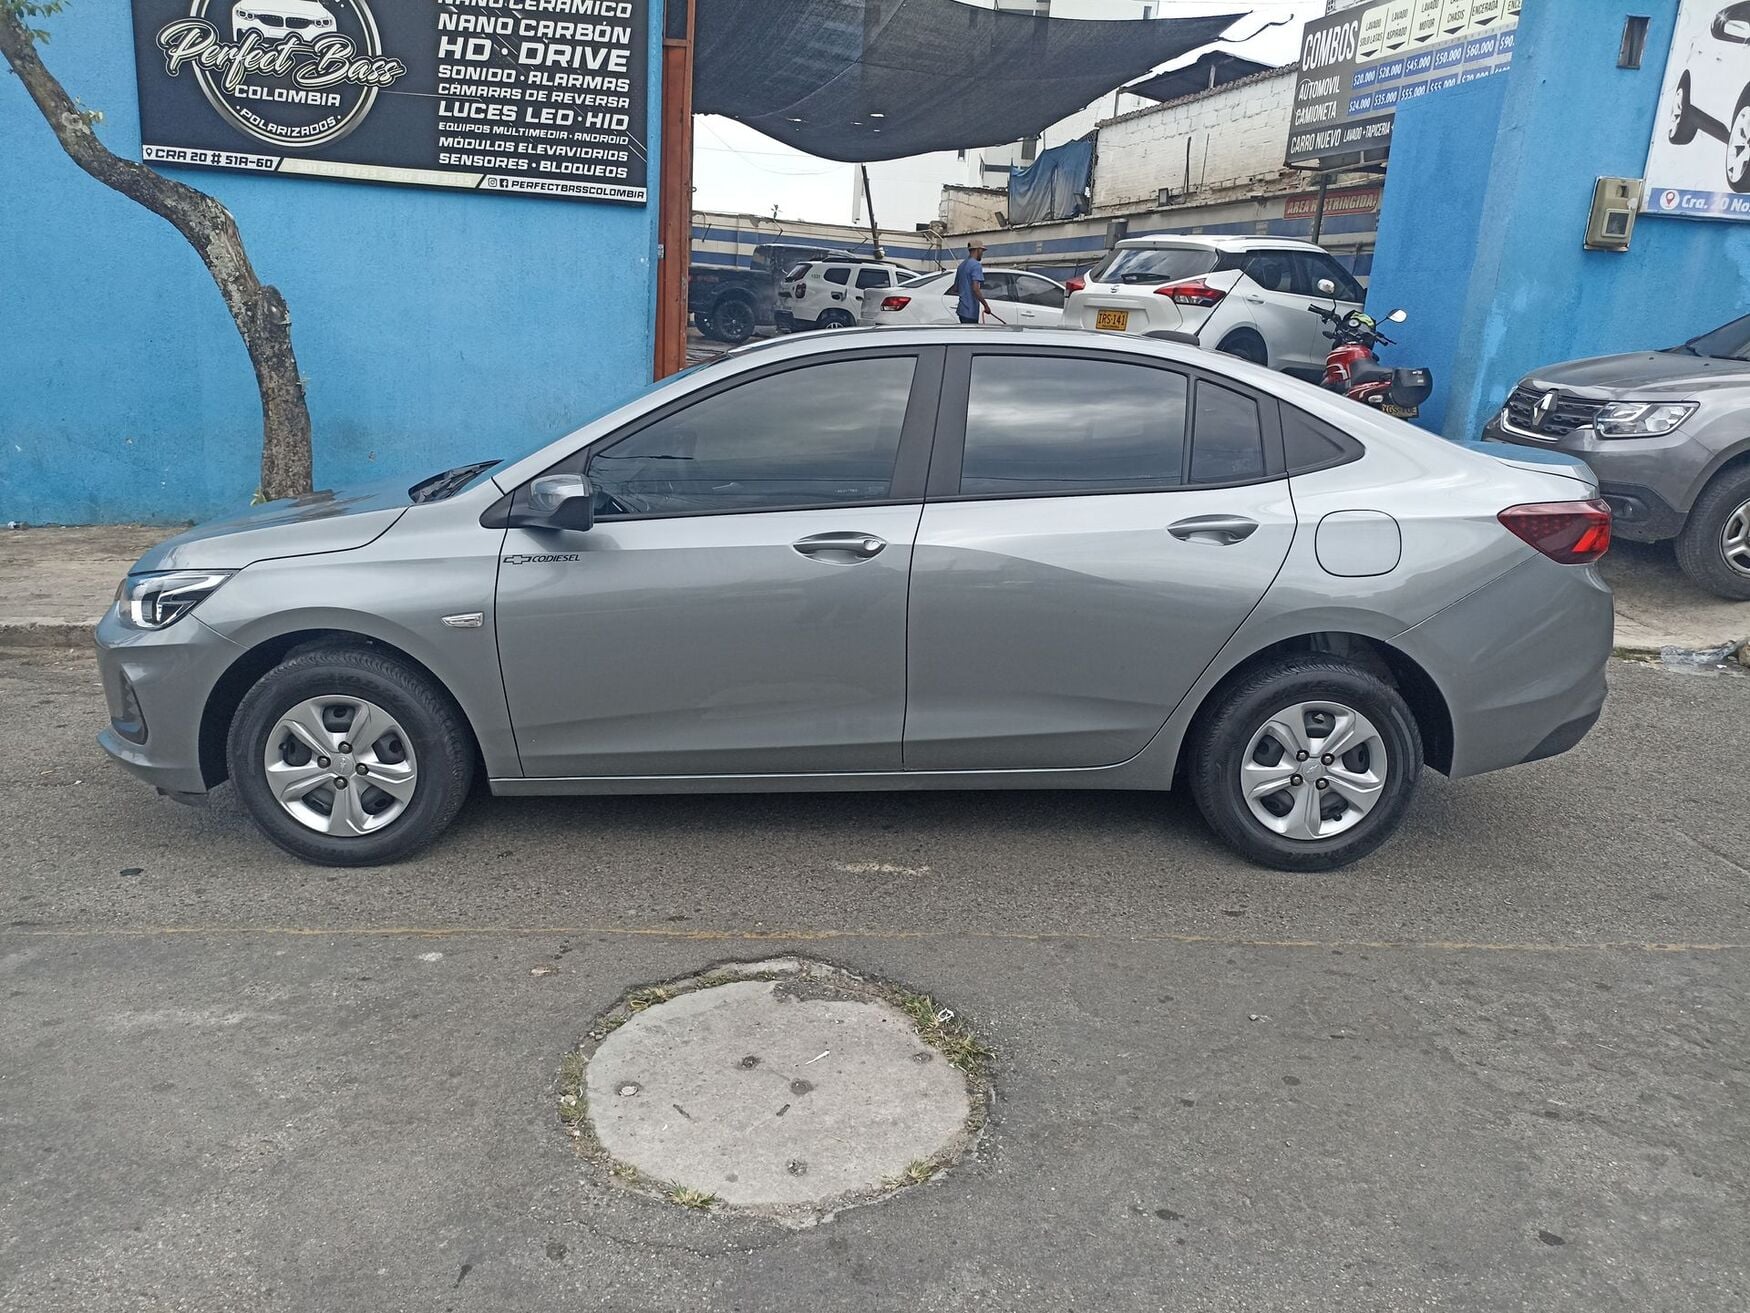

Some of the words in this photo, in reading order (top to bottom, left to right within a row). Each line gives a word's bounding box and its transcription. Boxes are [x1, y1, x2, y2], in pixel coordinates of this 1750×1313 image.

[437, 13, 514, 35] NANO
[519, 18, 632, 45] CARBÓN
[438, 35, 493, 61] HD
[518, 41, 631, 73] DRIVE
[1302, 20, 1360, 72] COMBOS
[1499, 35, 1515, 50] $90.
[158, 19, 308, 93] Perfect
[296, 33, 405, 87] Bass
[438, 64, 517, 83] SONIDO
[528, 71, 630, 92] ALARMAS
[1298, 75, 1341, 101] AUTOMOVIL
[234, 84, 341, 107] COLOMBIA
[438, 82, 522, 100] CÁMARAS
[525, 89, 547, 102] DE
[551, 91, 630, 109] REVERSA
[240, 108, 337, 137] POLARIZADOS
[438, 100, 518, 121] LUCES
[525, 107, 575, 126] LED
[585, 113, 630, 131] HID
[1295, 100, 1337, 126] CAMIONETA
[438, 122, 491, 135] EQUIPOS
[492, 126, 568, 141] MULTIMEDIA
[573, 132, 629, 146] ANDROID
[1290, 133, 1315, 154] CARRO
[1315, 128, 1342, 149] NUEVO
[155, 148, 187, 161] CRA
[190, 151, 208, 163] 20
[210, 151, 222, 165] #
[225, 155, 274, 169] 51A-60
[438, 135, 515, 152] MÓDULOS
[518, 143, 629, 162] ELEVAVIDRIOS
[438, 153, 529, 171] SENSORES
[539, 161, 629, 179] BLOQUEOS
[511, 180, 645, 199] PERFECTBASSCOLOMBIA
[1681, 194, 1708, 209] Cra.
[532, 554, 581, 563] CODIESEL
